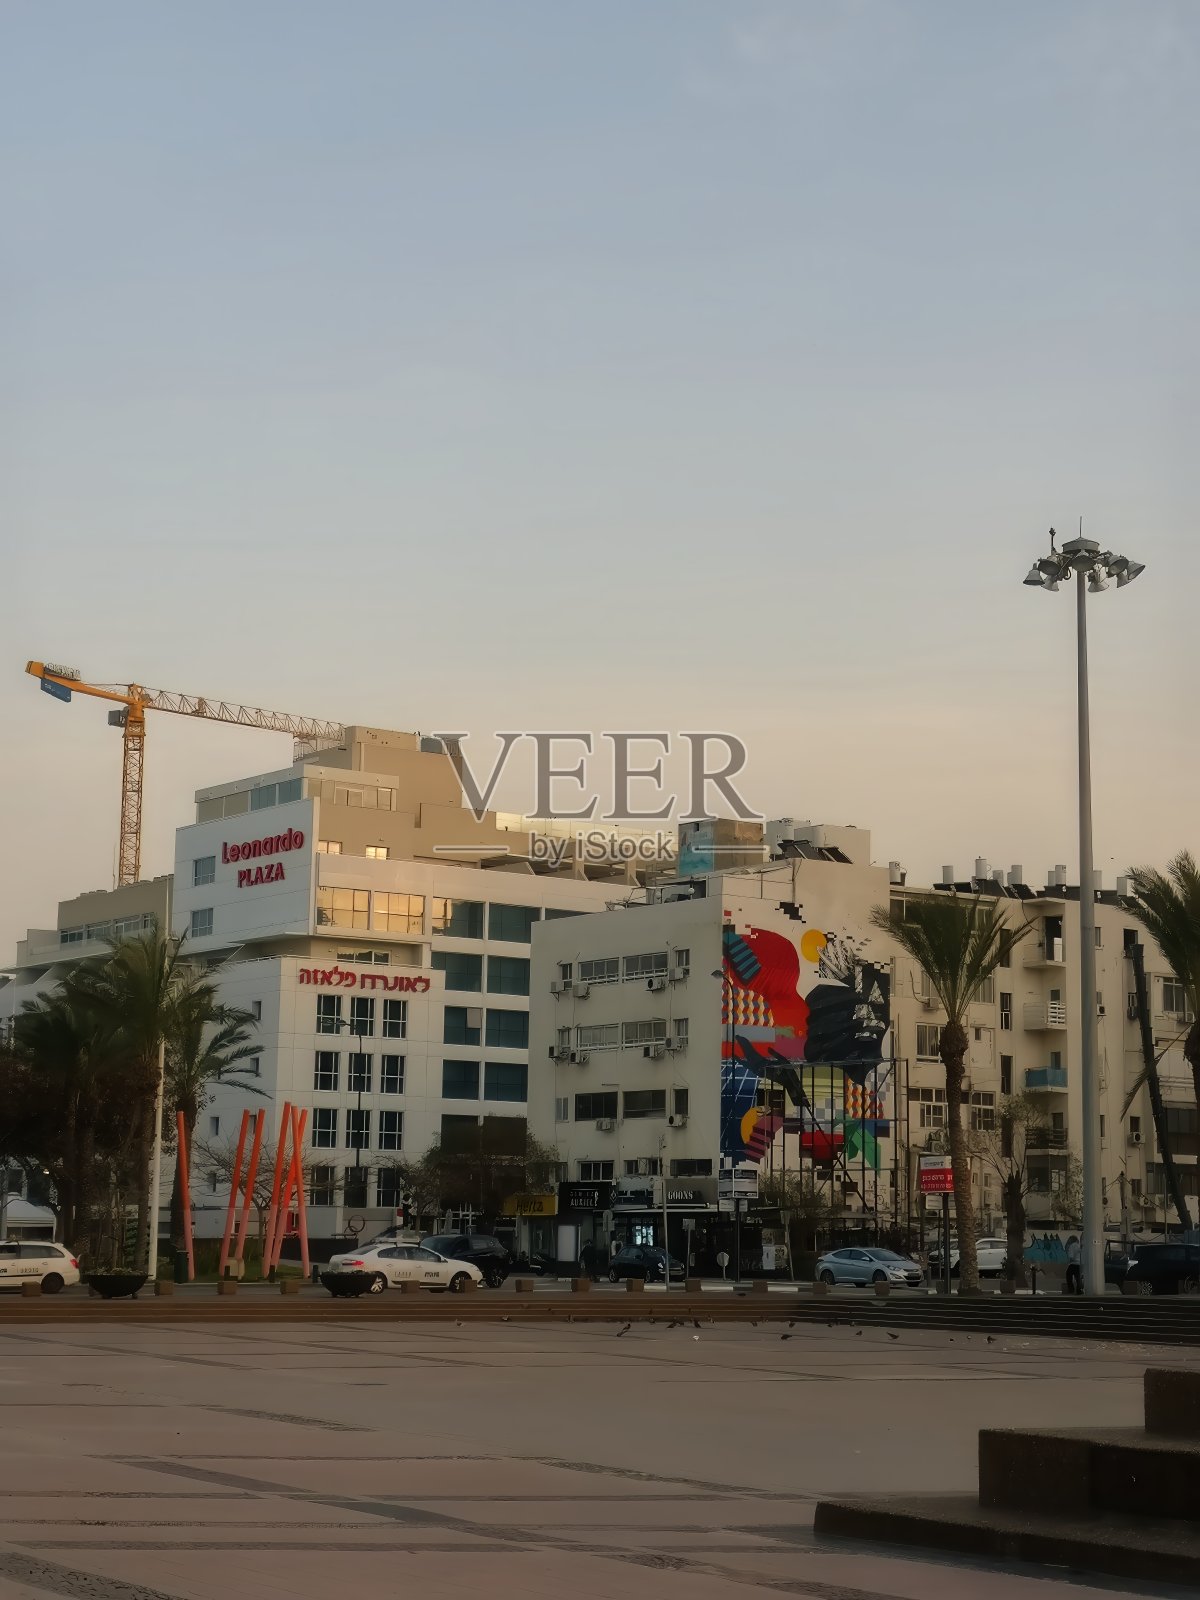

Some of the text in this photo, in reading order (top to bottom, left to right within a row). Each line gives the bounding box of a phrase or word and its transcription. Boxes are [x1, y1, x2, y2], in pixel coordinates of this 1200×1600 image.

[222, 827, 304, 864] Leonardo
[237, 862, 285, 888] PLAZA
[299, 965, 430, 993] לאונרדו פלאזה
